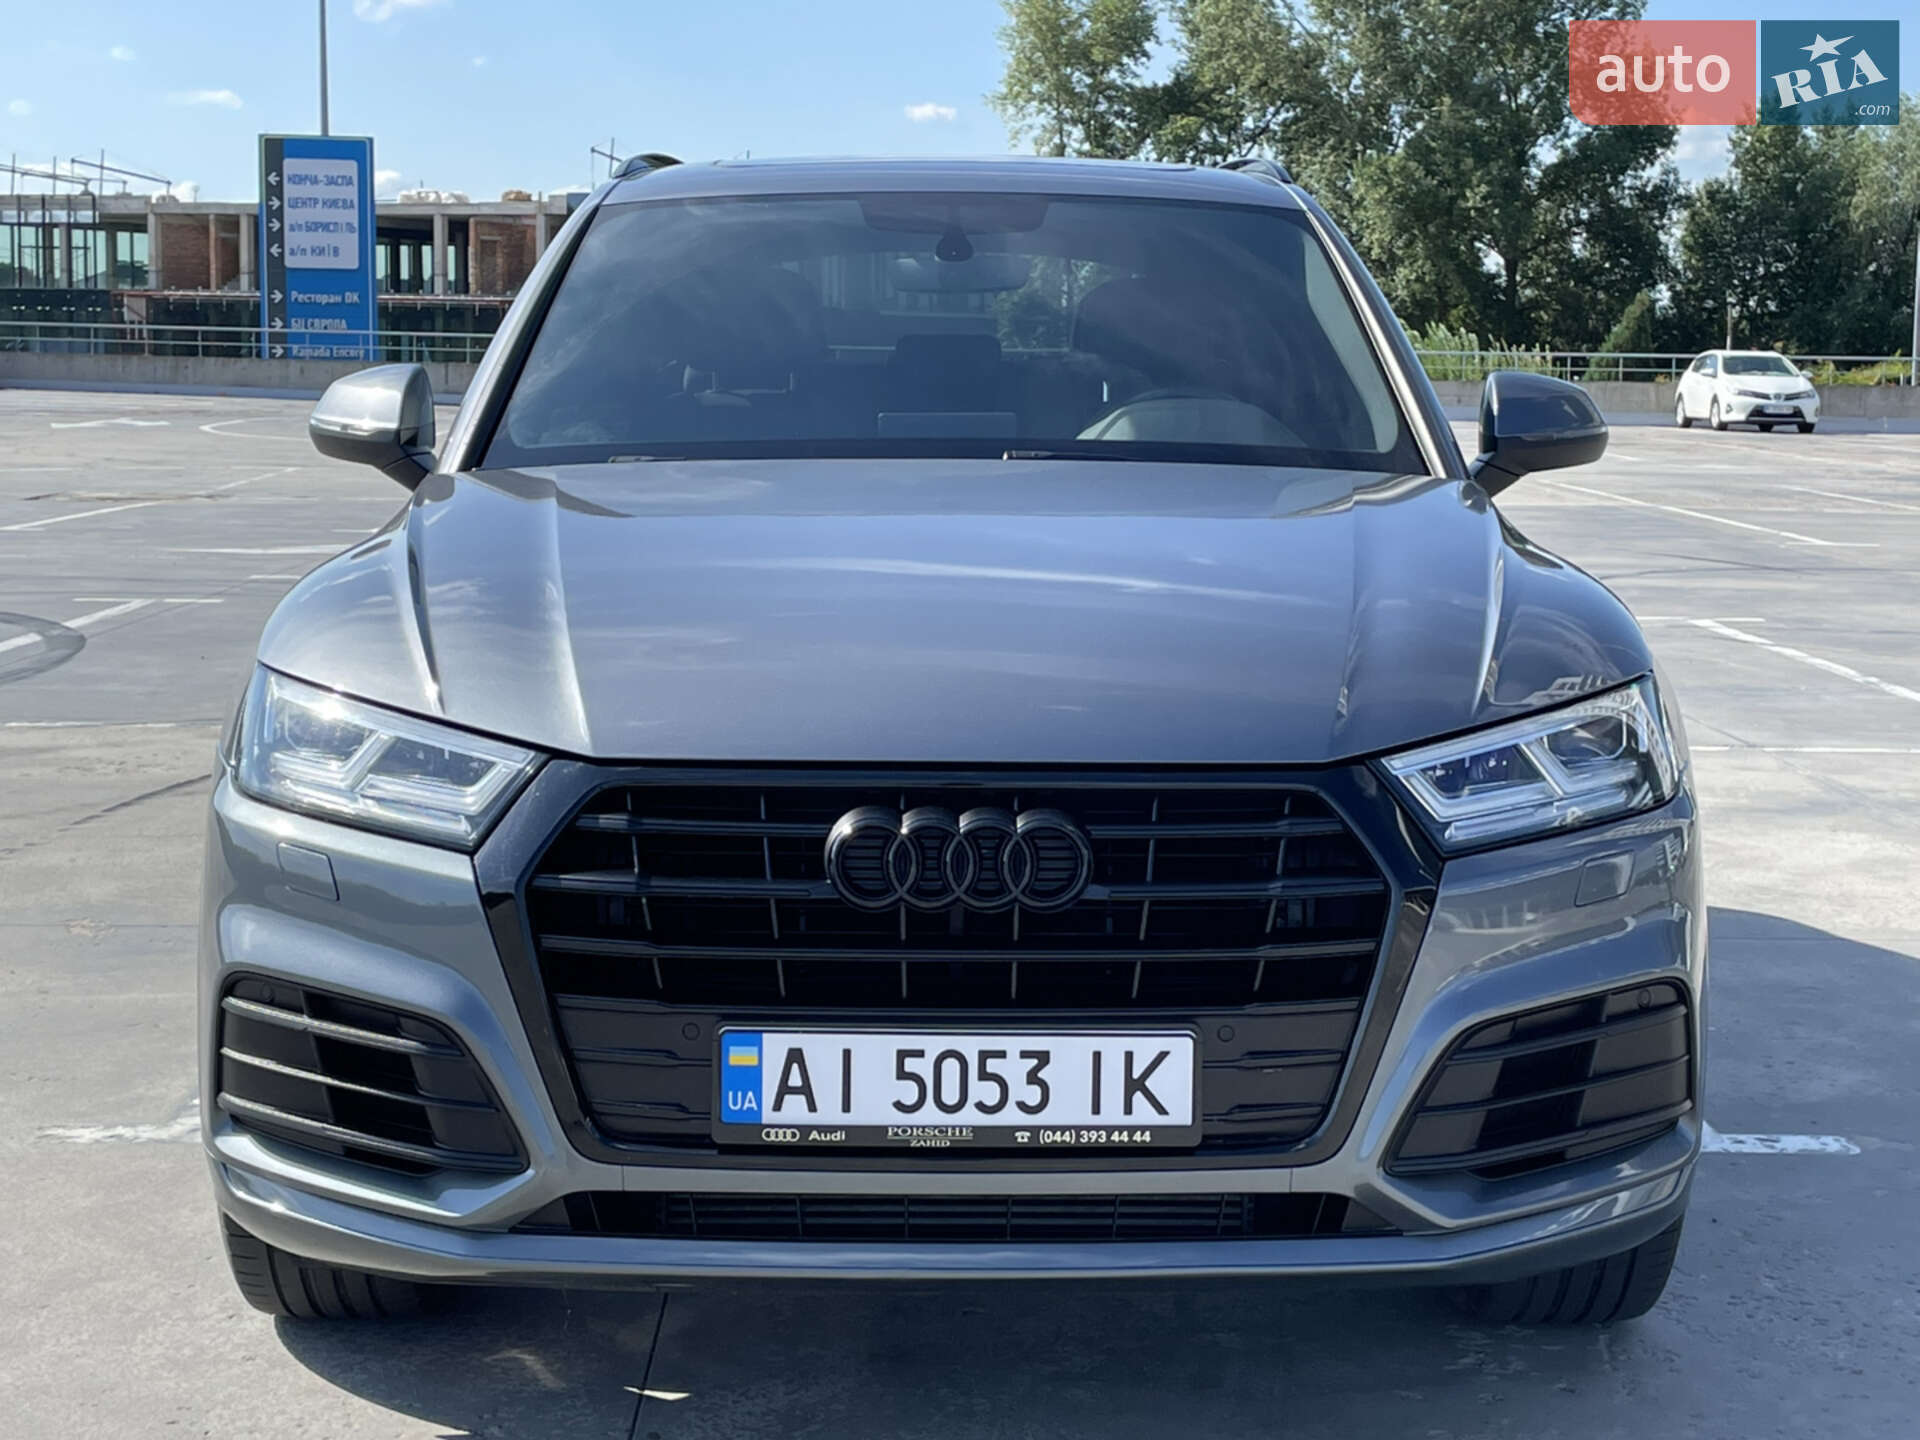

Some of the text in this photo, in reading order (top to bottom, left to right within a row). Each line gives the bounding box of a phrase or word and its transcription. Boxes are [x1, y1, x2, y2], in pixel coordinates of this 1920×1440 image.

[287, 197, 320, 210] ЦЕНТР
[288, 245, 308, 257] а/п
[290, 290, 342, 306] Ресторан
[771, 1047, 1172, 1116] AI 5053 IK
[728, 1090, 758, 1111] UA
[808, 1129, 846, 1141] Audi
[887, 1126, 974, 1137] PORSCHE
[1039, 1129, 1152, 1145] (044) 393 44 44
[910, 1139, 951, 1147] ZAHID
